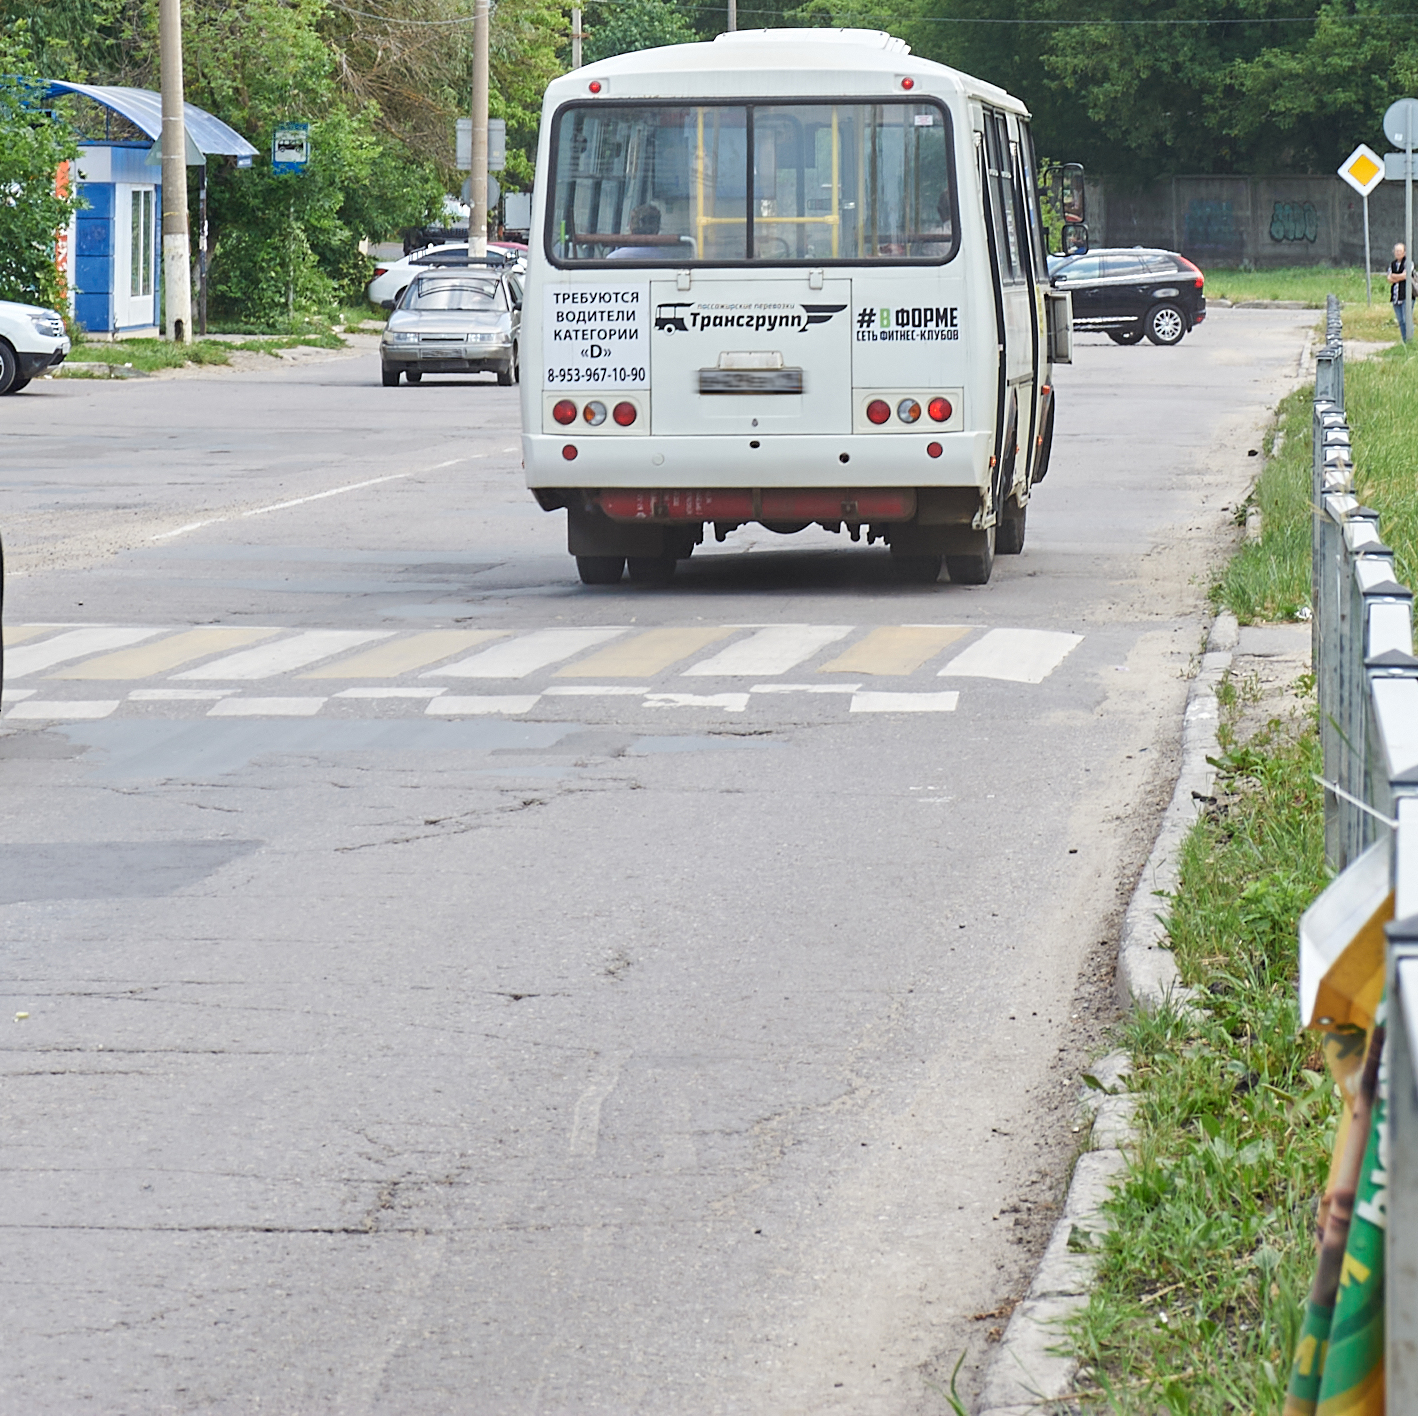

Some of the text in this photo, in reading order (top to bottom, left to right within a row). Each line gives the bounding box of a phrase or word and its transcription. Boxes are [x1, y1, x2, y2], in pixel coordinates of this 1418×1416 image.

[553, 291, 639, 304] ТРЕБУЮТСЯ
[556, 310, 636, 325] ВОДИТЕЛИ
[690, 312, 802, 332] Трансгрупп
[895, 307, 959, 328] ФОРМЕ
[553, 328, 639, 341] КАТЕГОРИИ
[856, 329, 959, 342] СЕТЬ ФИТНЕС-КЛУБОВ
[547, 366, 647, 383] 8-953-967-10-90
